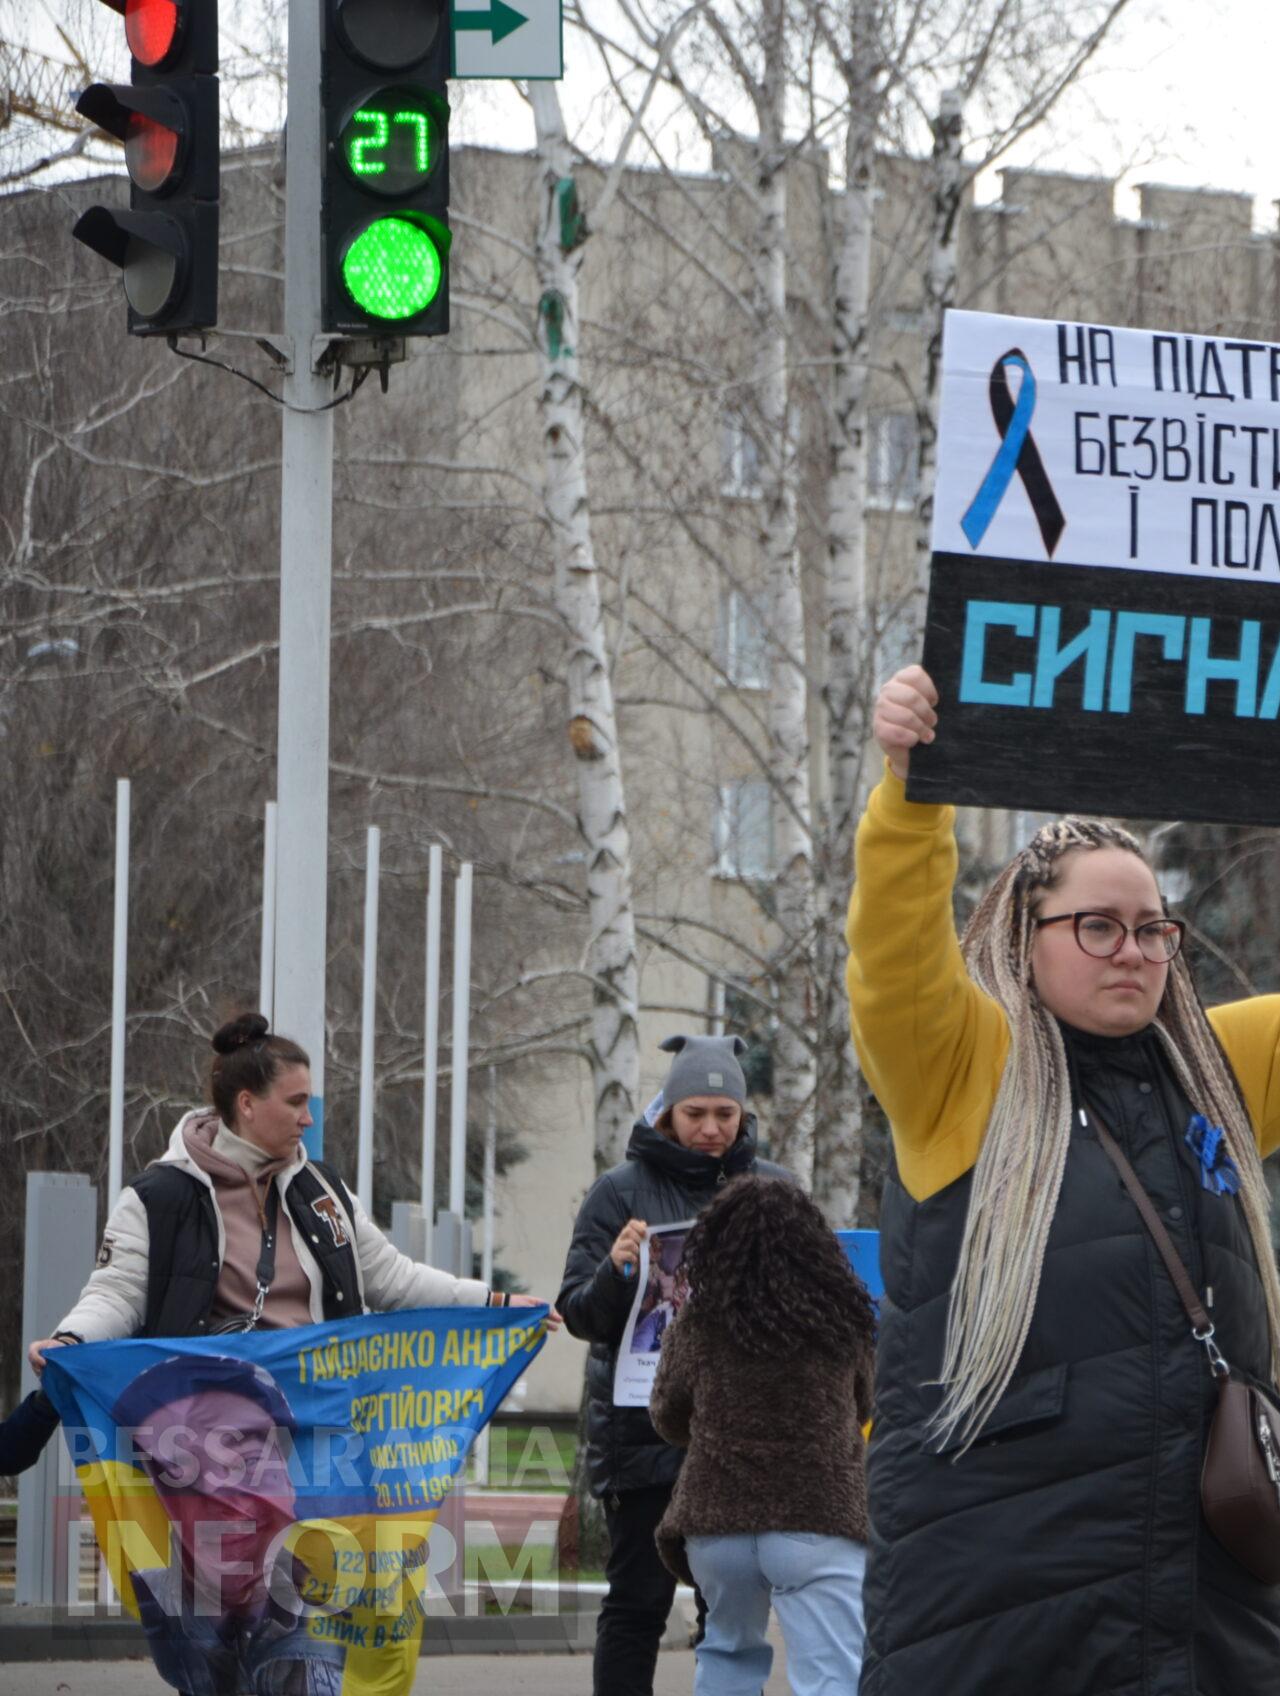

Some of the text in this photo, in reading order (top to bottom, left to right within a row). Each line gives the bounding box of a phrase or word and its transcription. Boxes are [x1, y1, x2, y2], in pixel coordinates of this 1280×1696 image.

[350, 110, 430, 175] 27
[1057, 324, 1117, 387] НА
[297, 1329, 436, 1384] ГАЙДАЄНКО
